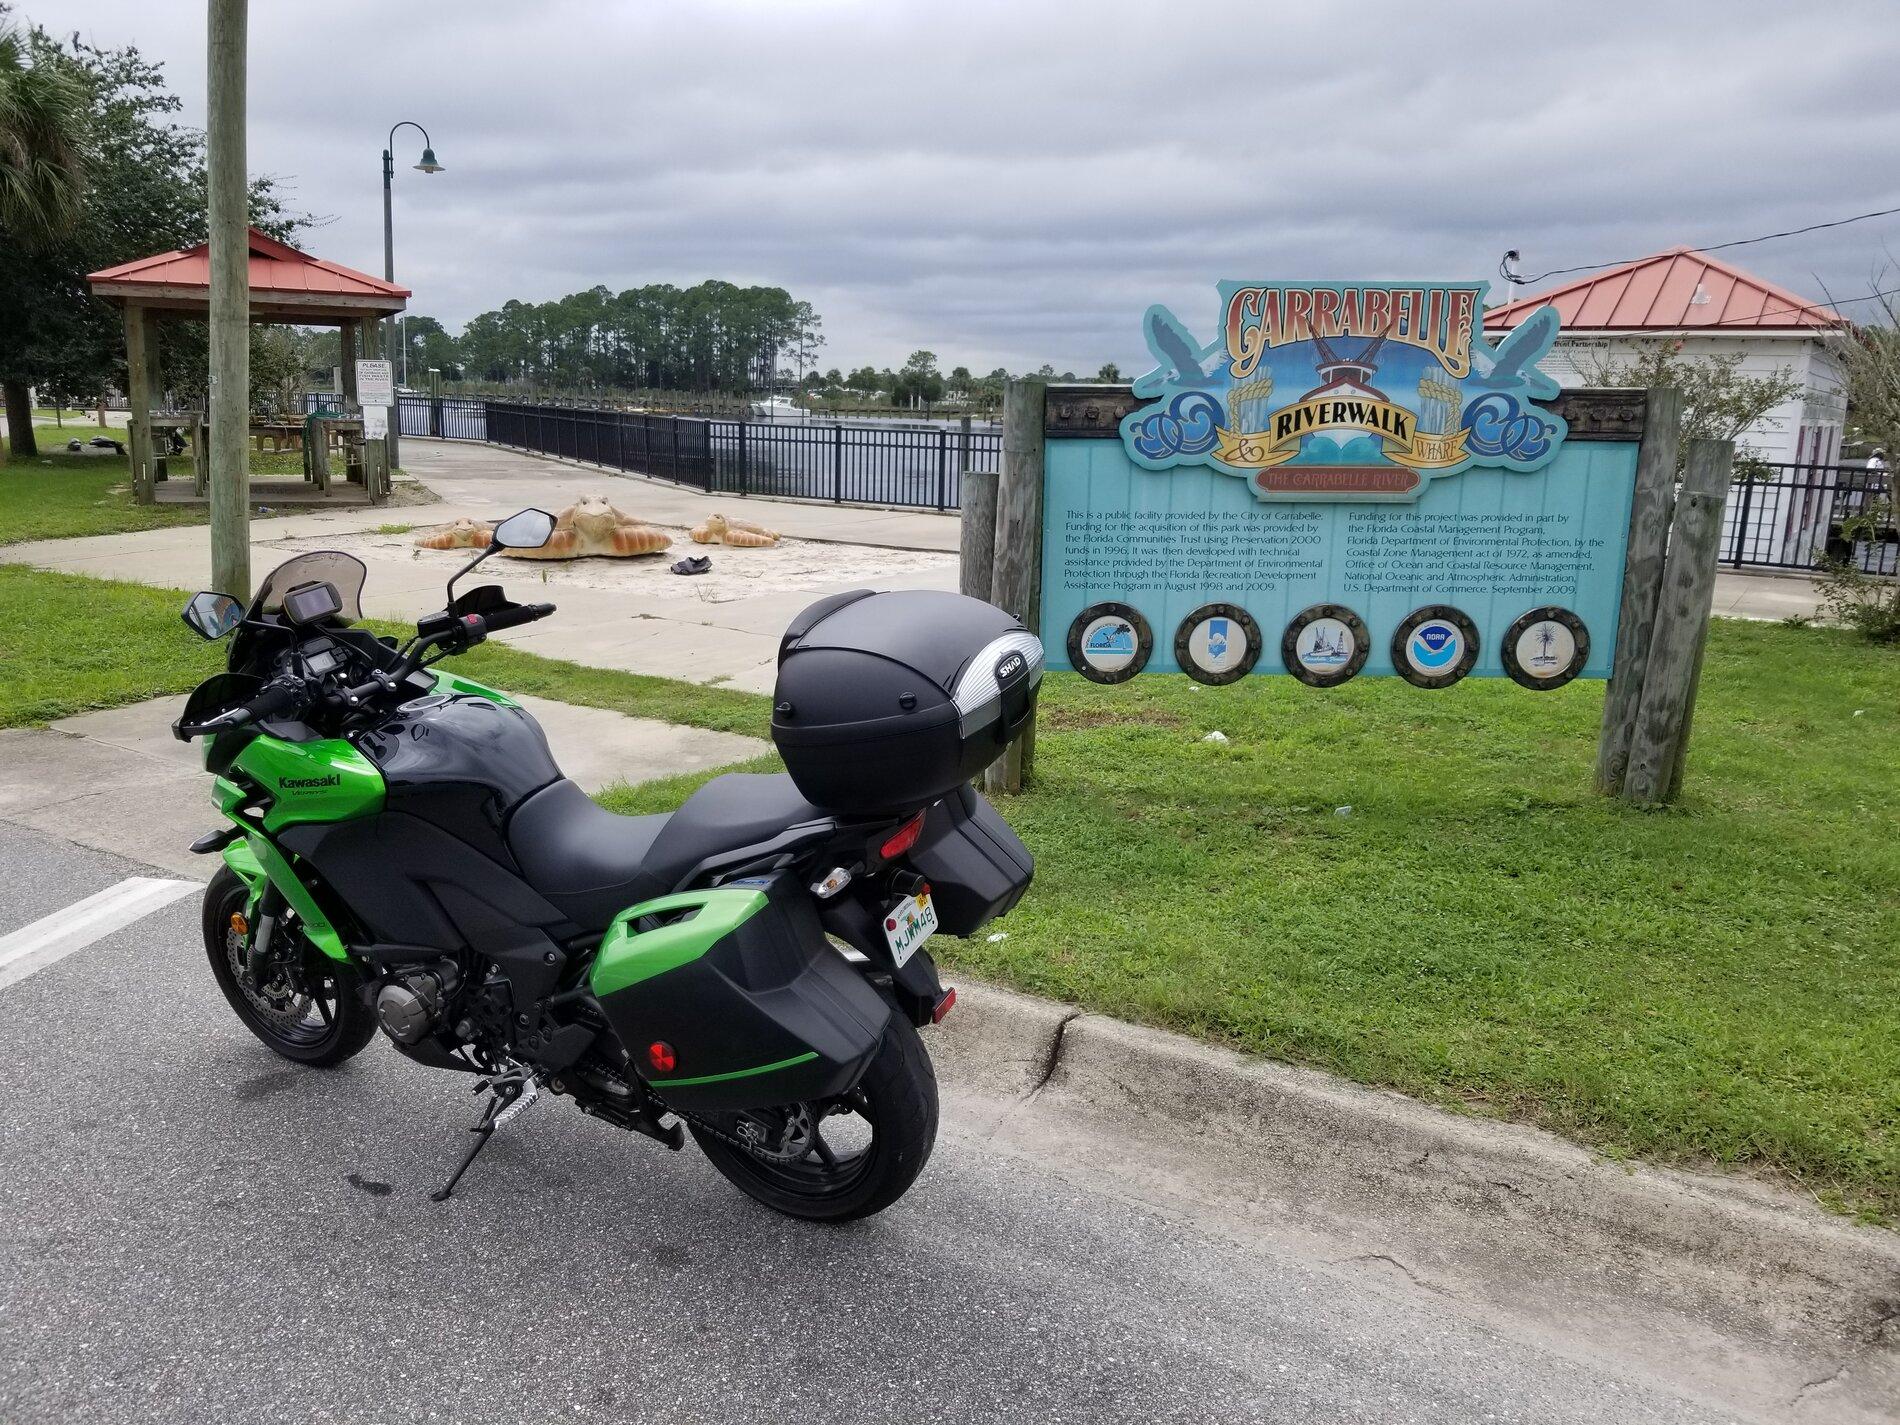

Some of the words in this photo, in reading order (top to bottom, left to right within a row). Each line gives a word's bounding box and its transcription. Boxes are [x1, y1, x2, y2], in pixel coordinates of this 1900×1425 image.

[1225, 287, 1481, 379] CARRABELLE
[1276, 402, 1409, 441] RIVERWALK
[1224, 438, 1265, 463] &
[1415, 439, 1458, 460] WHARF
[1267, 472, 1289, 486] THE
[1292, 472, 1368, 488] CARRABELLE
[1373, 473, 1409, 488] RIVER
[1067, 511, 1084, 519] This
[1105, 511, 1131, 520] public
[1135, 511, 1162, 521] facility
[1165, 512, 1205, 521] provided
[1209, 512, 1219, 521] by
[1241, 512, 1259, 521] City
[1275, 512, 1323, 520] Carrabelle.
[1349, 512, 1386, 523] Funding
[1424, 513, 1457, 523] project
[1481, 514, 1522, 523] provided
[1537, 514, 1554, 523] part
[1558, 514, 1569, 523] by
[1066, 523, 1102, 533] Funding
[1138, 524, 1186, 533] acquisition
[1221, 524, 1240, 533] park
[1264, 524, 1304, 533] provided
[1307, 524, 1318, 533] by
[1438, 525, 1501, 535] Management
[1083, 534, 1113, 542] Florida
[1116, 535, 1176, 543] Communities
[1180, 535, 1200, 544] Trust
[1204, 536, 1228, 546] using
[1231, 536, 1288, 544] Preservation
[1291, 536, 1321, 544] 2000
[1347, 536, 1378, 544] Florida
[1381, 537, 1436, 546] Department
[1453, 537, 1518, 545] Environmental
[1575, 538, 1585, 549] by
[1186, 548, 1235, 557] developed
[1260, 548, 1300, 556] technical
[1346, 548, 1380, 556] Coastal
[1410, 549, 1473, 559] Management
[1493, 550, 1502, 558] of
[1113, 559, 1152, 567] provided
[1156, 559, 1167, 568] by
[1188, 559, 1241, 568] Department
[1346, 560, 1375, 568] Office
[1391, 560, 1422, 569] Ocean
[1483, 561, 1527, 570] Resource
[1064, 569, 1110, 578] Protection
[1114, 570, 1148, 580] through
[1170, 570, 1199, 578] Florida
[1254, 571, 1316, 581] Development
[1345, 572, 1382, 580] National
[1386, 572, 1423, 580] Oceanic
[1447, 572, 1504, 583] Atmospheric
[1064, 581, 1110, 589] Assistance
[1114, 582, 1150, 592] Program
[1165, 582, 1196, 592] August
[1200, 582, 1223, 590] 1998
[1246, 582, 1276, 591] 2009.
[1364, 584, 1419, 593] Department
[1492, 585, 1543, 595] September
[1000, 657, 1021, 678] SHAD
[278, 774, 340, 788] Kawasaki
